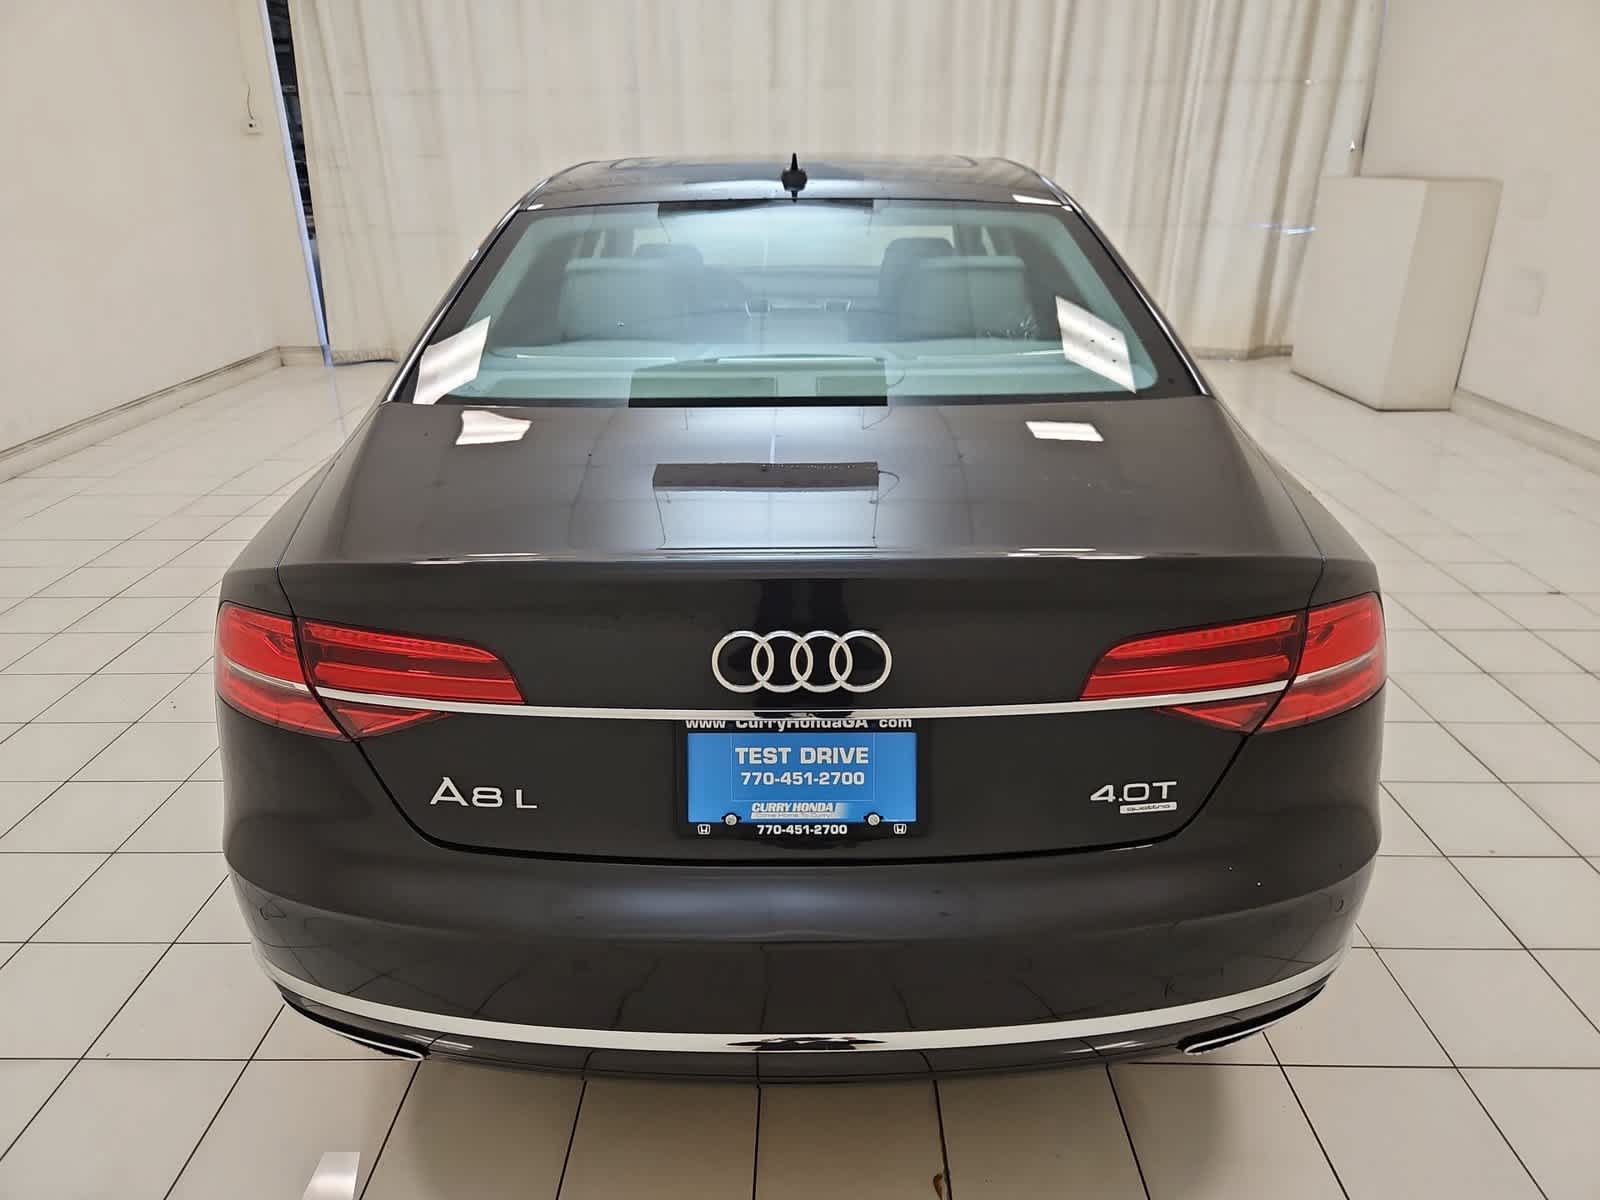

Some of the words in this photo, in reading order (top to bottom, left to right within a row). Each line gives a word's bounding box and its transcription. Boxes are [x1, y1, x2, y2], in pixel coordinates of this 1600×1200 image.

[735, 747, 792, 765] TEST
[800, 747, 869, 764] DRIVE
[740, 771, 865, 785] 770-451-2700
[430, 776, 504, 808] A8
[515, 789, 538, 809] L
[1090, 781, 1177, 802] 4.0T
[752, 802, 792, 812] CURRY
[792, 802, 834, 812] HONDA
[1126, 803, 1170, 812] quattro
[756, 824, 848, 835] 770-451-2700
